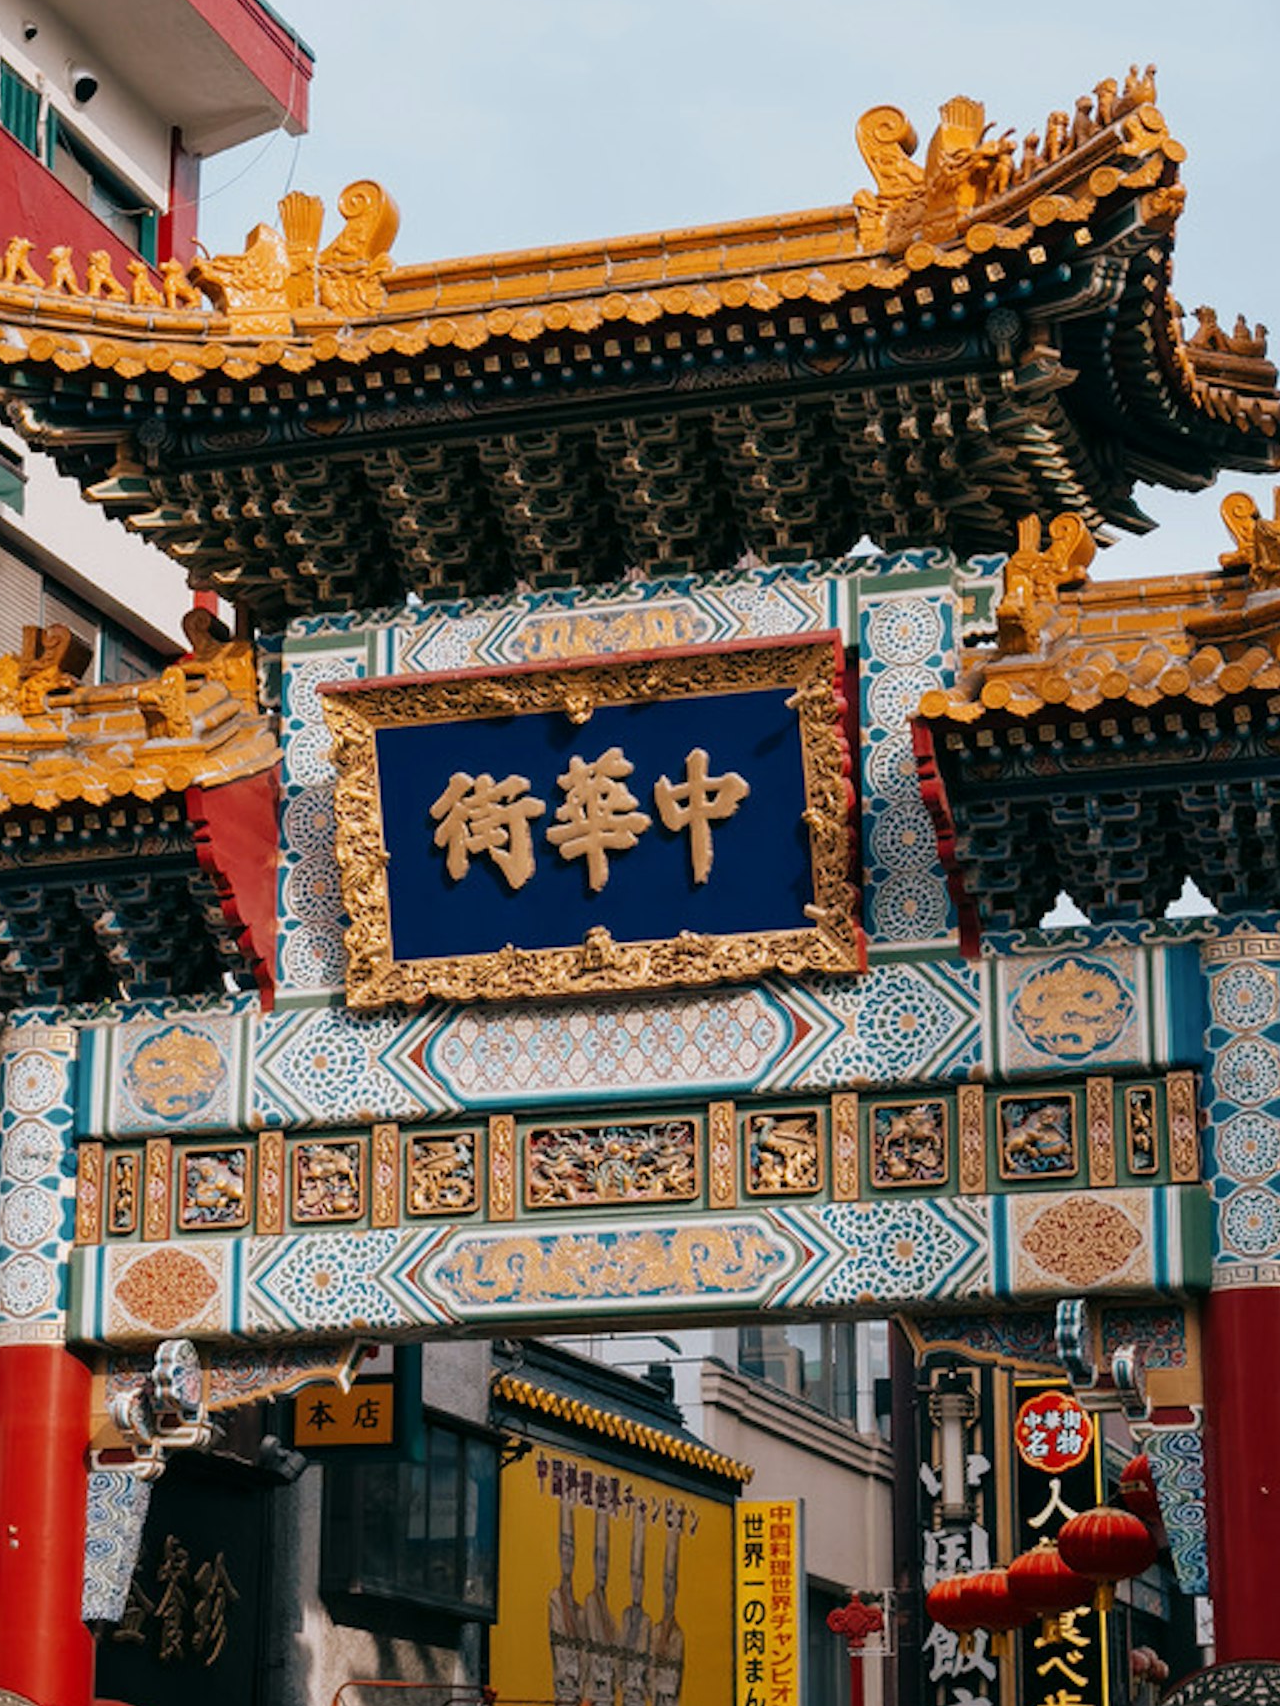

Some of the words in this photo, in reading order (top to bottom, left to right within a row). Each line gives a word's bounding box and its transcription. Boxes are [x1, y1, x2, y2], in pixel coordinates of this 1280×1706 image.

[430, 746, 751, 892] 中華街
[306, 1399, 382, 1431] 本店
[1024, 1428, 1084, 1458] 名物
